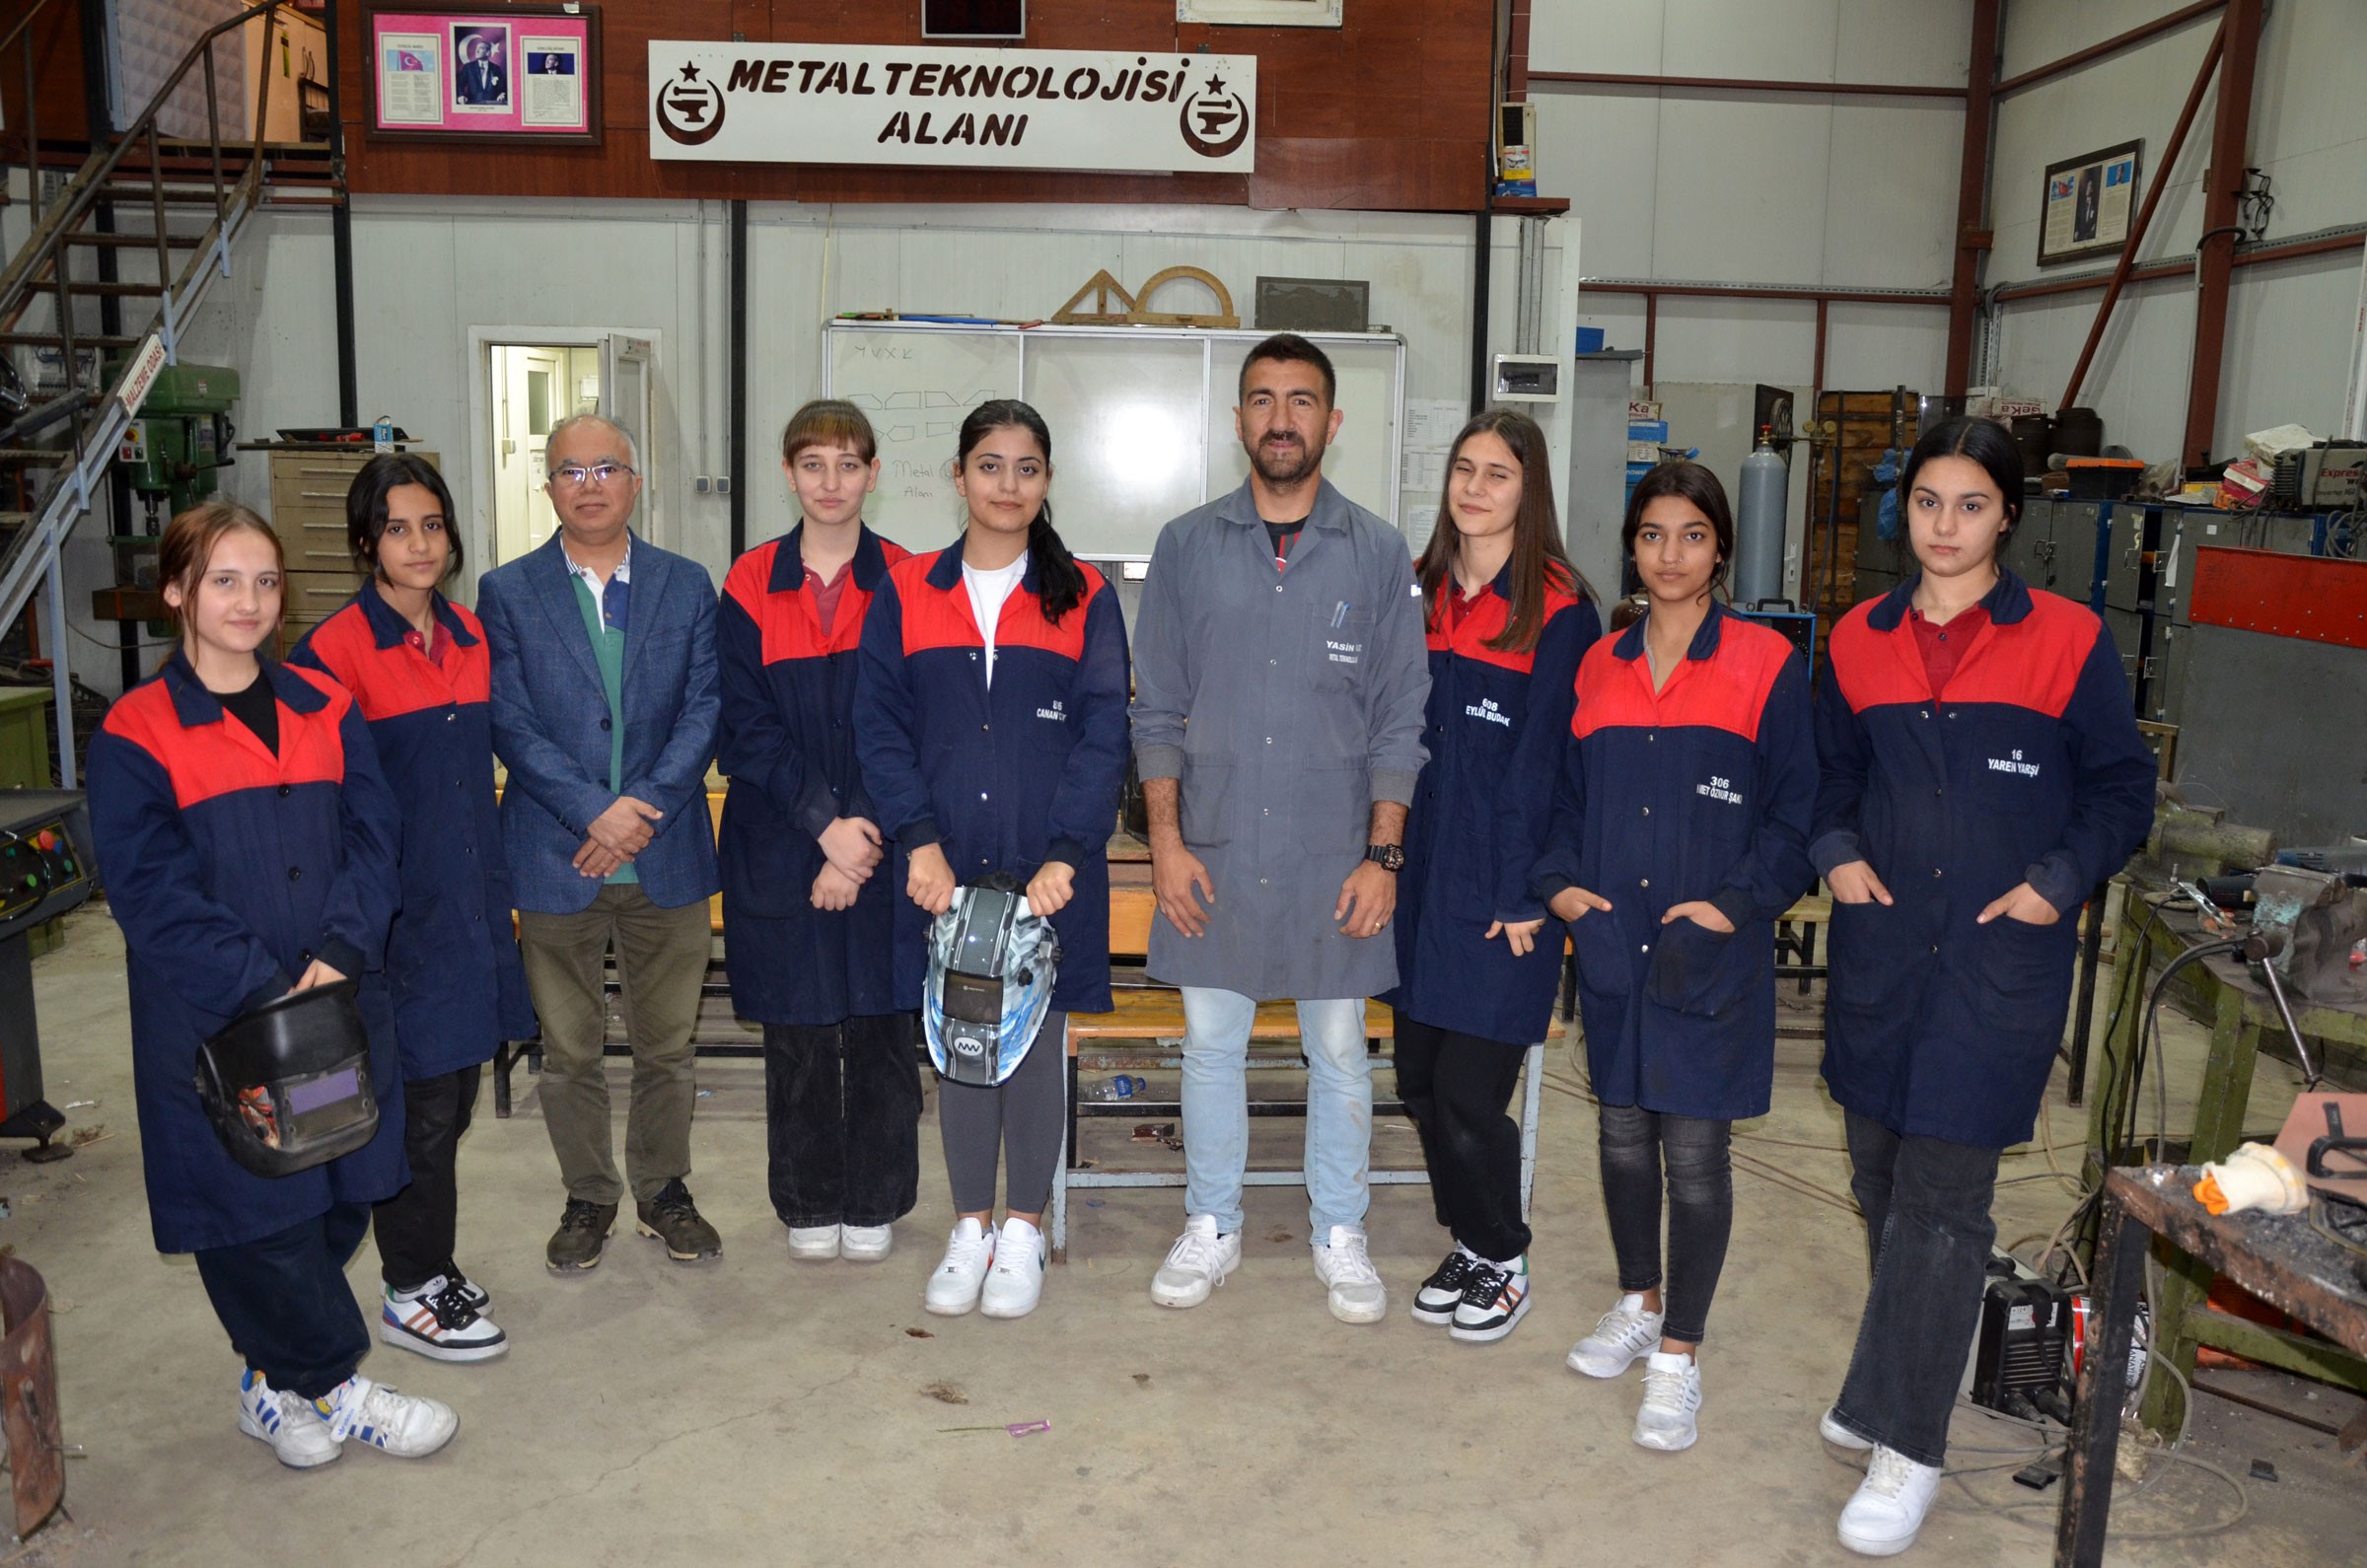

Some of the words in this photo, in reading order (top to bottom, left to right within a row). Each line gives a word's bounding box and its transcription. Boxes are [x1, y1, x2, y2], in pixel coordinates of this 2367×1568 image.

[727, 59, 876, 95] METAL
[885, 56, 1190, 104] TEKNOLOJİSİ
[877, 111, 1029, 147] ALANI
[1326, 640, 1355, 652] YASİN
[1482, 697, 1498, 711] 608
[2011, 748, 2023, 761] 16
[1987, 757, 2017, 773] YAREN
[1709, 775, 1731, 790] 306
